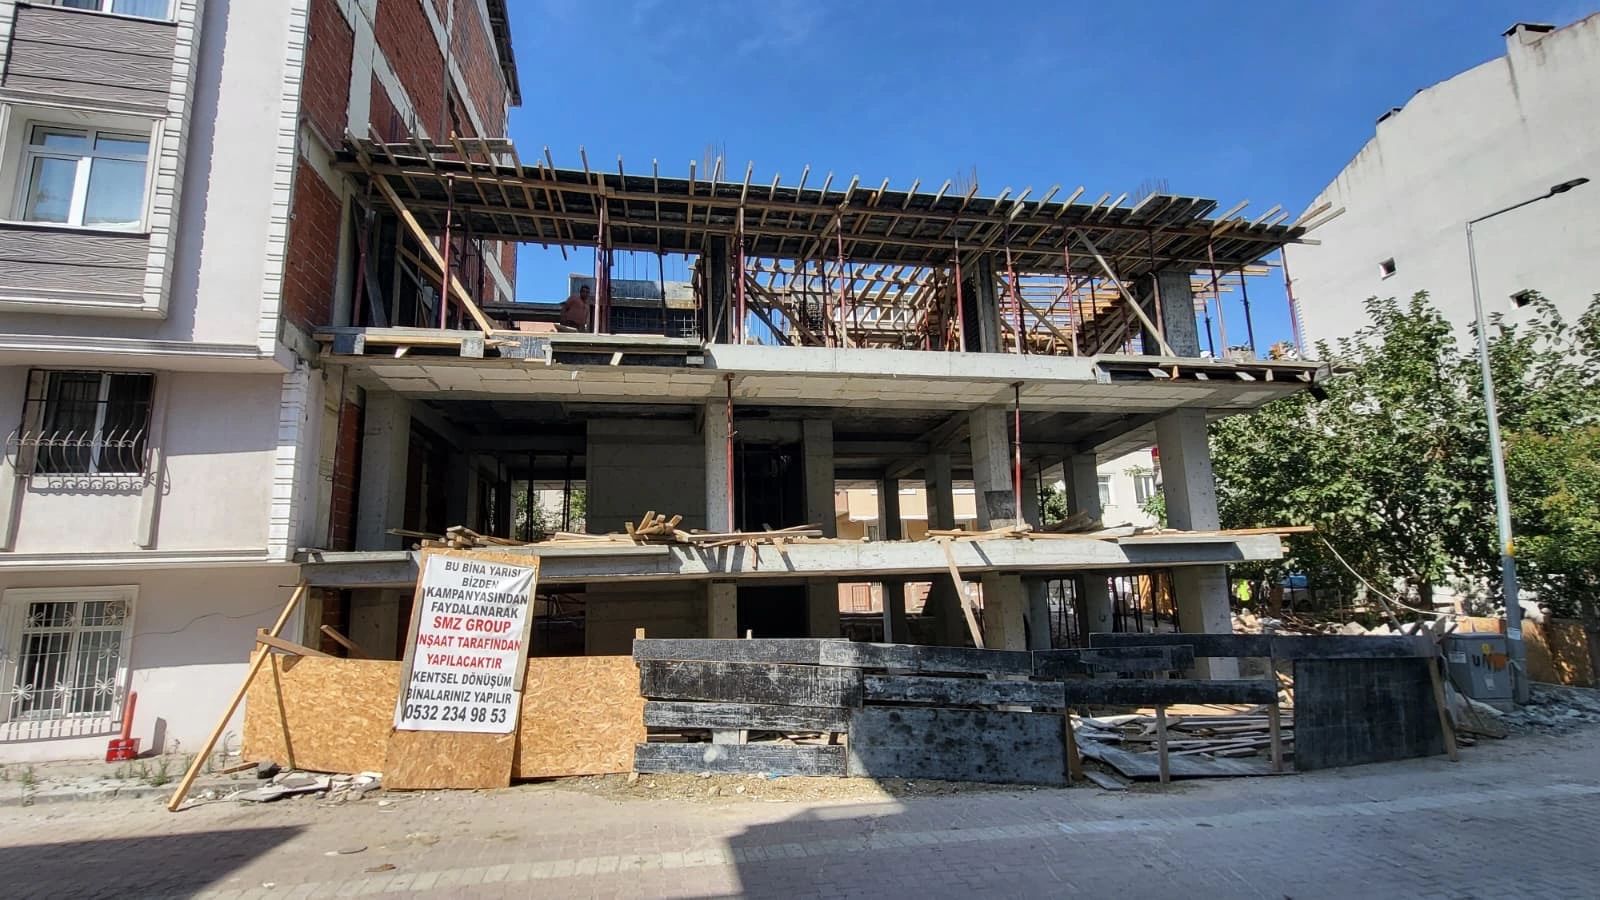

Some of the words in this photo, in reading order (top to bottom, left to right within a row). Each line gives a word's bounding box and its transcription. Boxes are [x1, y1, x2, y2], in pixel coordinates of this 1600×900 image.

[445, 561, 459, 573] BU
[462, 560, 486, 575] BİNA
[462, 576, 499, 589] BİZDEN
[426, 586, 528, 605] KAMPANYASINDAN
[431, 601, 519, 619] FAYDALANARAK
[433, 616, 463, 631] SMZ
[465, 618, 511, 633] GROUP
[457, 636, 522, 651] TARAFINDAN
[427, 653, 503, 669] YAPILACAKTIR
[412, 671, 459, 685] KENTSEL
[462, 671, 512, 688] DÖNÜŞÜM
[474, 691, 512, 704] YAPILIR
[406, 704, 438, 721] 0532
[441, 706, 466, 722] 234
[470, 708, 486, 723] 98
[490, 708, 507, 724] 53
